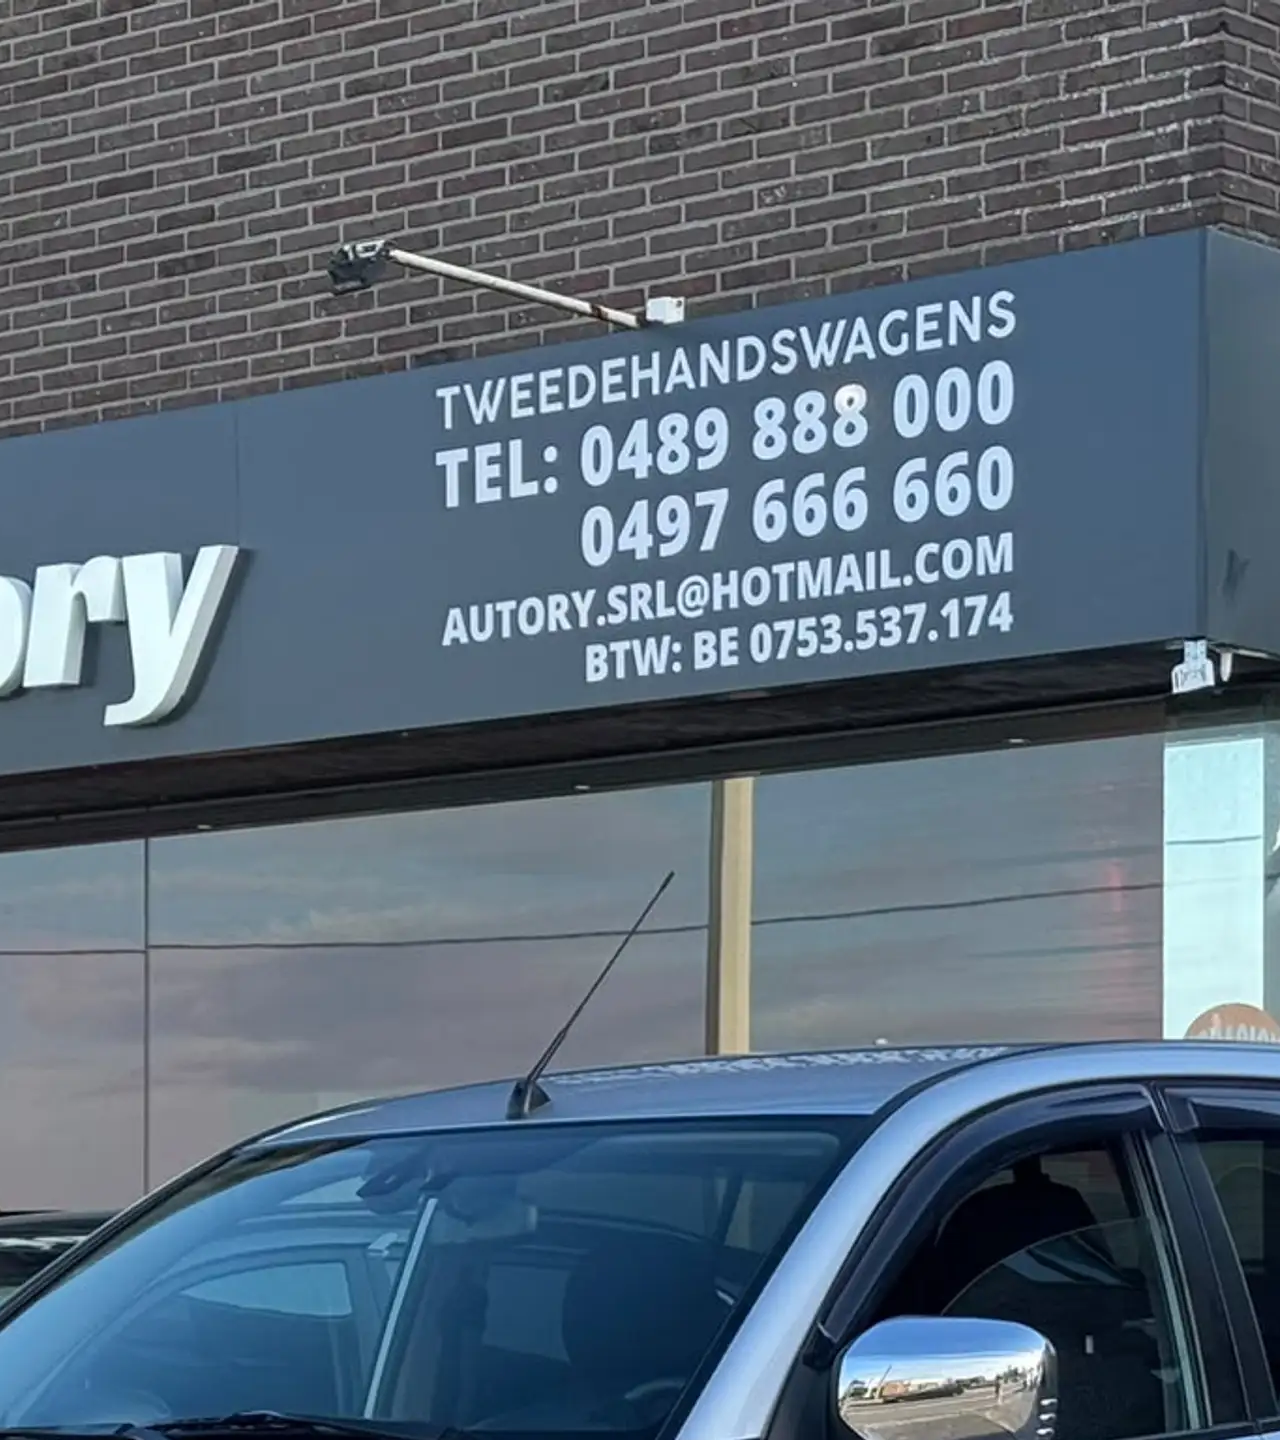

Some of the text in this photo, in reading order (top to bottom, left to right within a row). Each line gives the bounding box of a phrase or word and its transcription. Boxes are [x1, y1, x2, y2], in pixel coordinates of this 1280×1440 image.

[436, 291, 1017, 430] TWEEDEHANDSWAGENS
[435, 359, 1015, 509] TEL: 0489 888 000
[580, 445, 1014, 567] 0497 666 660
[441, 531, 1014, 647] AUTORY.SRL@HOTMAIL.COM
[585, 591, 1014, 683] BTW: BE 0753.537.174
